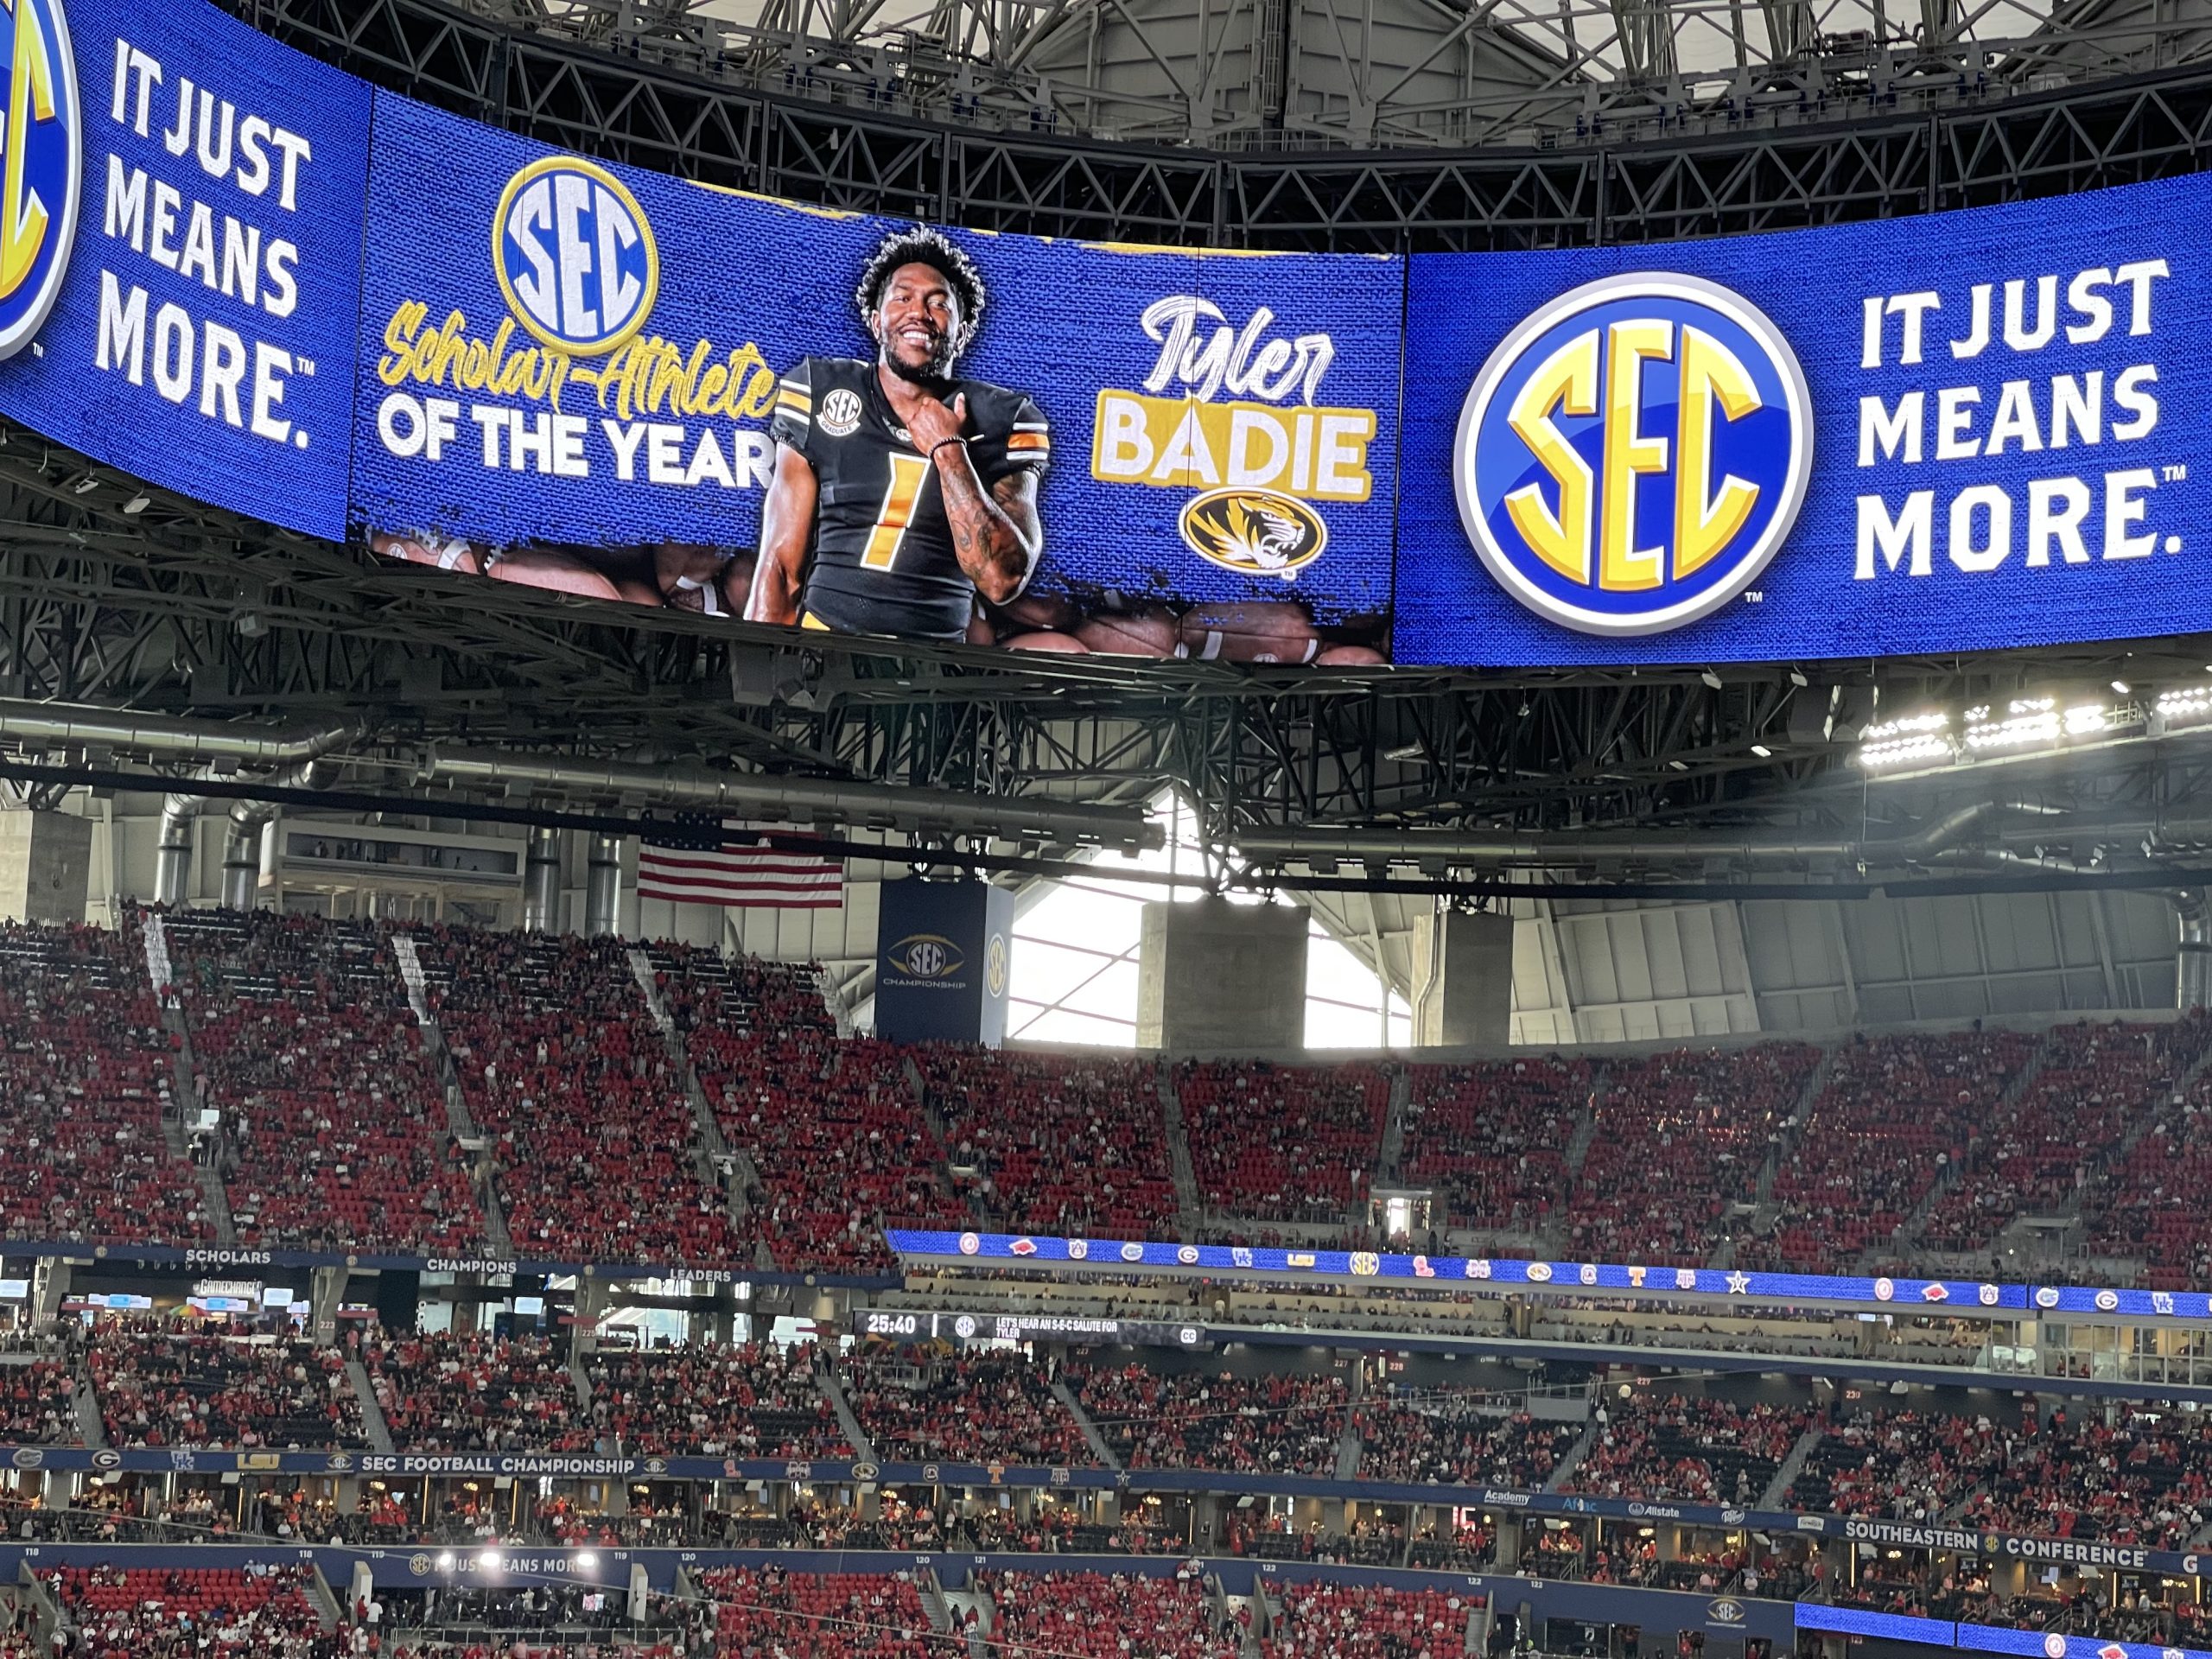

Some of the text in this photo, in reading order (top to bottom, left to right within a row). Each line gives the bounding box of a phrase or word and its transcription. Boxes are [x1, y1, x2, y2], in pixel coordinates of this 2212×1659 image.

[110, 37, 312, 213] IT JUST
[104, 152, 300, 319] MEANS
[508, 172, 641, 338] SEC
[1860, 257, 2170, 369] IT JUST
[95, 270, 309, 450] MORE.
[378, 300, 778, 421] Scholar-Athlete
[1141, 294, 1335, 408] Tyler
[827, 391, 858, 423] SEC
[1857, 364, 2158, 467] MEANS
[821, 420, 854, 435] GRADUATE
[378, 392, 774, 491] OF THE YEAR
[1098, 396, 1371, 496] BADIE
[1505, 319, 1763, 593] SEC
[1854, 468, 2183, 581] MORE.
[909, 943, 943, 975] SEC
[989, 941, 1005, 989] SEC
[883, 977, 966, 989] CHAMPIONSHIP
[186, 1249, 271, 1265] SCHOLARS
[427, 1259, 517, 1274] CHAMPIONS
[1353, 1252, 1377, 1274] SEC
[670, 1268, 731, 1282] LEADERS
[868, 1314, 915, 1334] 25:40
[996, 1317, 1117, 1333] LET'S HEAR AN S-E-C SALUTE FOR
[996, 1327, 1020, 1339] TYLER
[237, 1453, 281, 1470] LSU
[362, 1456, 635, 1474] SEC FOOTBALL CHAMPIONSHIP
[1484, 1490, 1530, 1505] Academy
[1644, 1506, 1680, 1518] Allstate
[1846, 1521, 1978, 1549] SOUTHEASTERN
[681, 1553, 696, 1561] 120
[916, 1555, 930, 1564] 120
[975, 1555, 986, 1564] 121
[2006, 1537, 2145, 1567] CONFERENCE
[412, 1554, 428, 1573] SEC
[543, 1559, 588, 1573] MOR
[1262, 1563, 1276, 1573] 122
[2183, 1555, 2197, 1573] G
[1467, 1577, 1482, 1586] 122
[1530, 1580, 1543, 1589] 122
[1718, 1602, 1735, 1621] SEC
